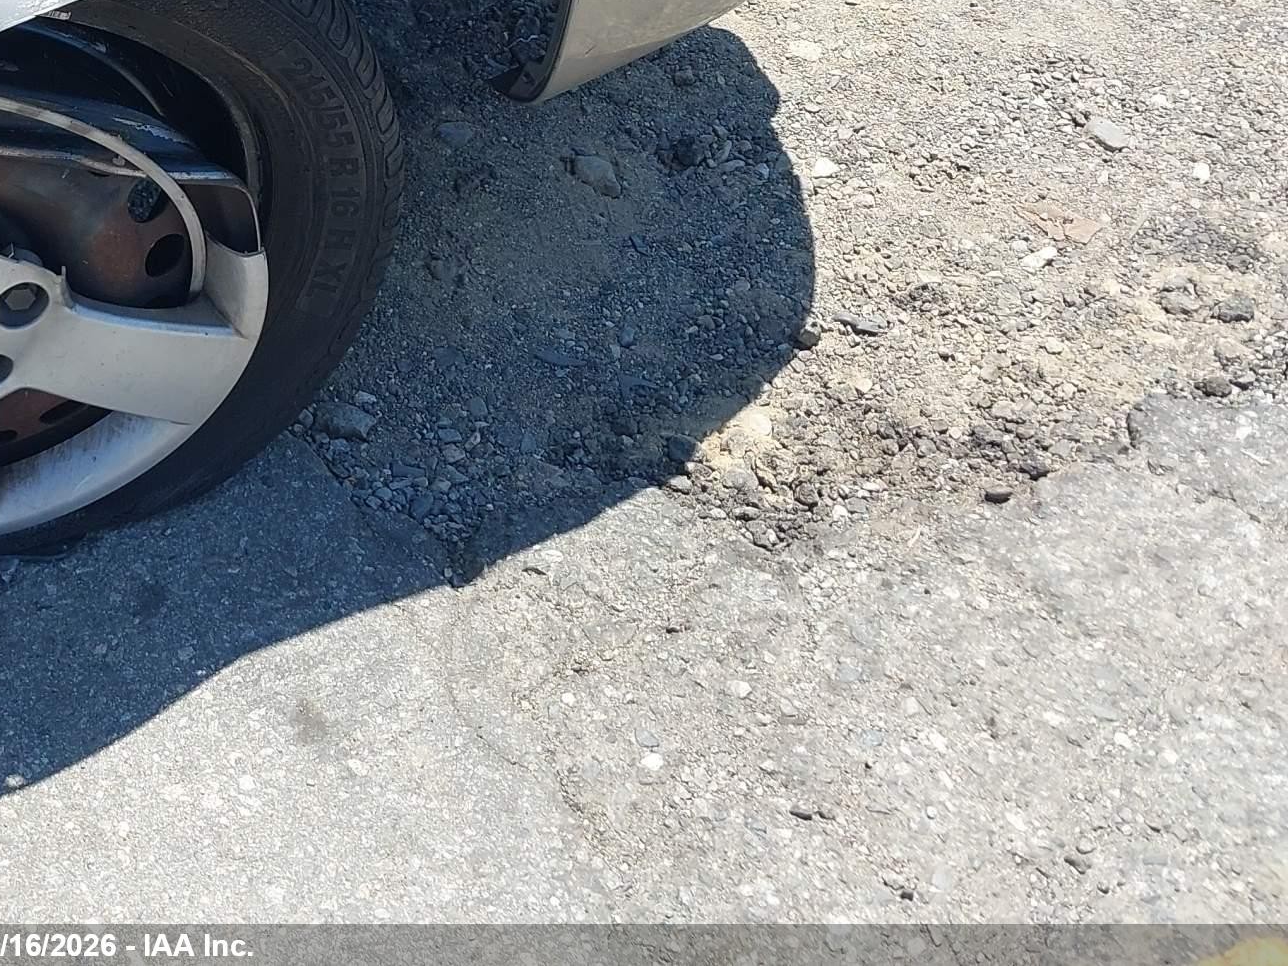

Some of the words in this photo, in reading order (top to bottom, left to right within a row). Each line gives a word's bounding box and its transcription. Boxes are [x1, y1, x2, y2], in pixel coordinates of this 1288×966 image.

[275, 56, 355, 148] 215/55
[329, 157, 361, 177] R
[330, 186, 362, 218] 16
